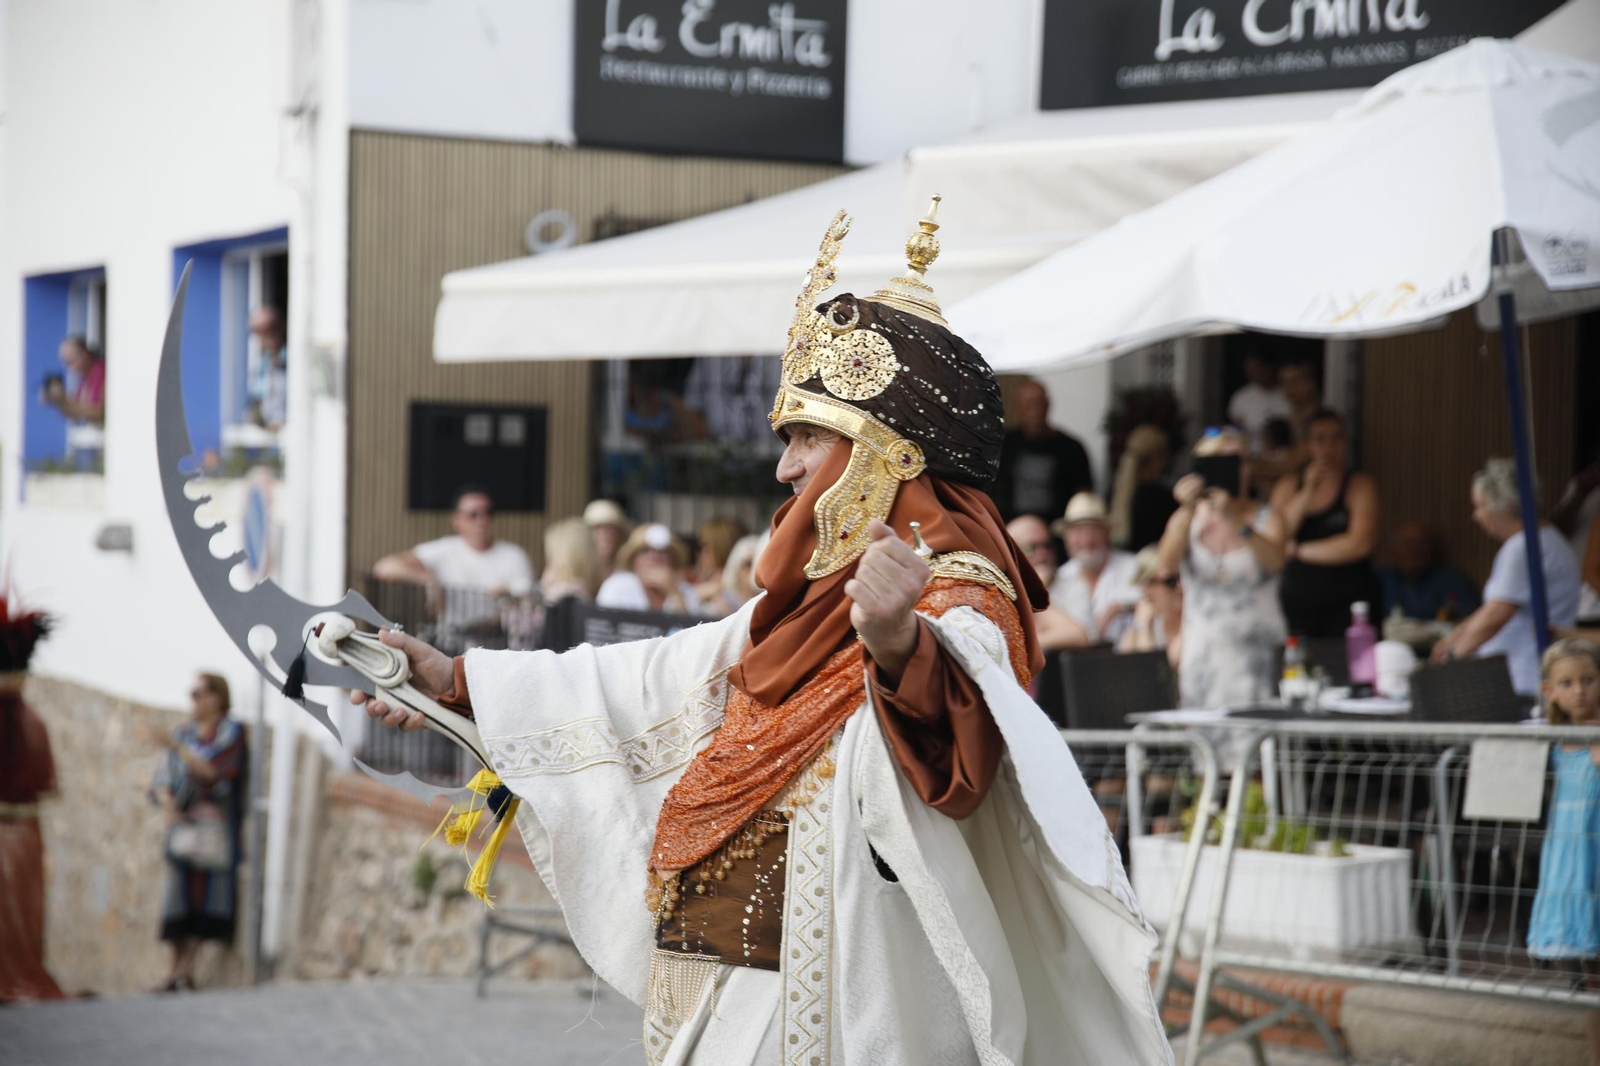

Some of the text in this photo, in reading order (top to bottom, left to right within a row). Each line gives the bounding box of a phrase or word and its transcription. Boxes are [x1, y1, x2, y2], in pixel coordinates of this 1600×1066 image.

[601, 0, 833, 68] La Ermita
[1154, 0, 1226, 61] La
[1330, 40, 1410, 70] RACIONES
[600, 54, 729, 92] Restaurante
[728, 71, 745, 98] y
